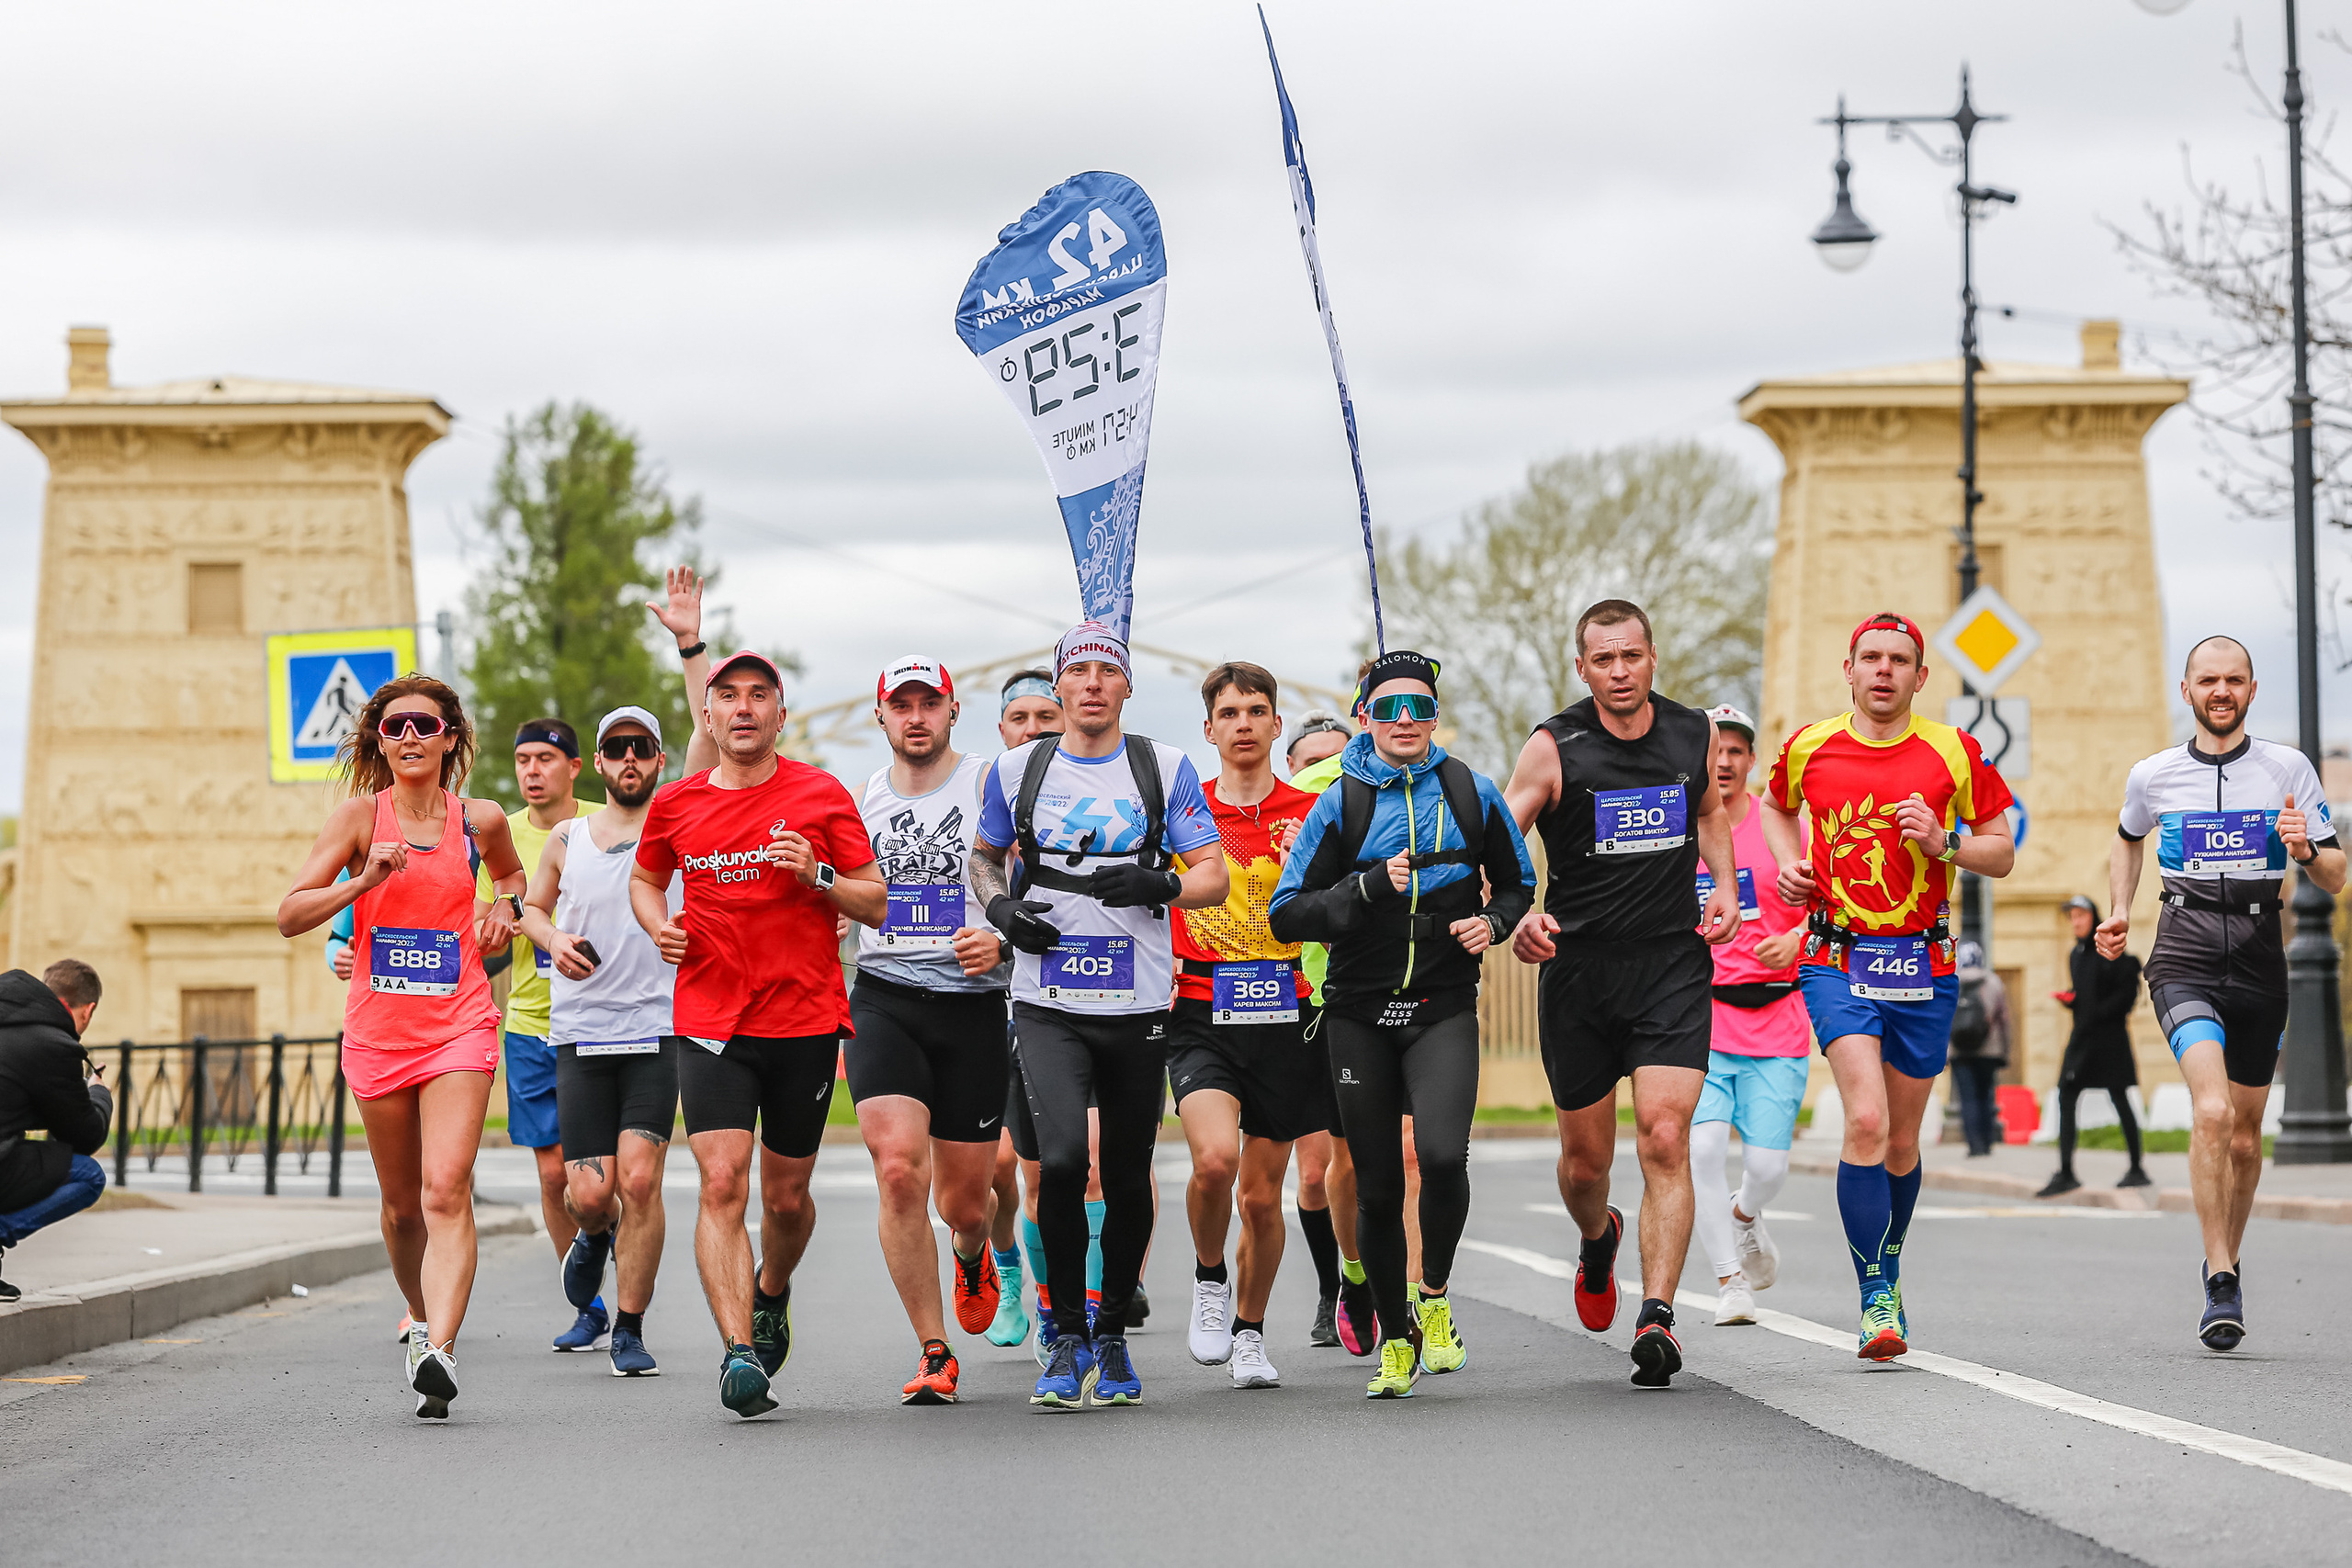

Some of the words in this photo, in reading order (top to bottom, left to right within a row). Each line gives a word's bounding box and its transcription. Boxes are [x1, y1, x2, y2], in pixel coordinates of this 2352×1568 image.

[1374, 654, 1426, 669] SALOMON
[1617, 807, 1666, 829] 330
[1614, 829, 1643, 838] БОГАТОВ
[2205, 830, 2245, 850] 106
[886, 840, 903, 850] RUN
[920, 843, 940, 855] RUN!
[712, 867, 760, 884] Team
[1107, 940, 1128, 948] 15.05
[389, 949, 442, 969] 888
[1061, 956, 1114, 976] 403
[1867, 957, 1919, 976] 446
[1233, 980, 1281, 999] 369
[1388, 1001, 1419, 1010] COMP
[1376, 1018, 1410, 1026] PORT
[1383, 1010, 1413, 1018] RESS
